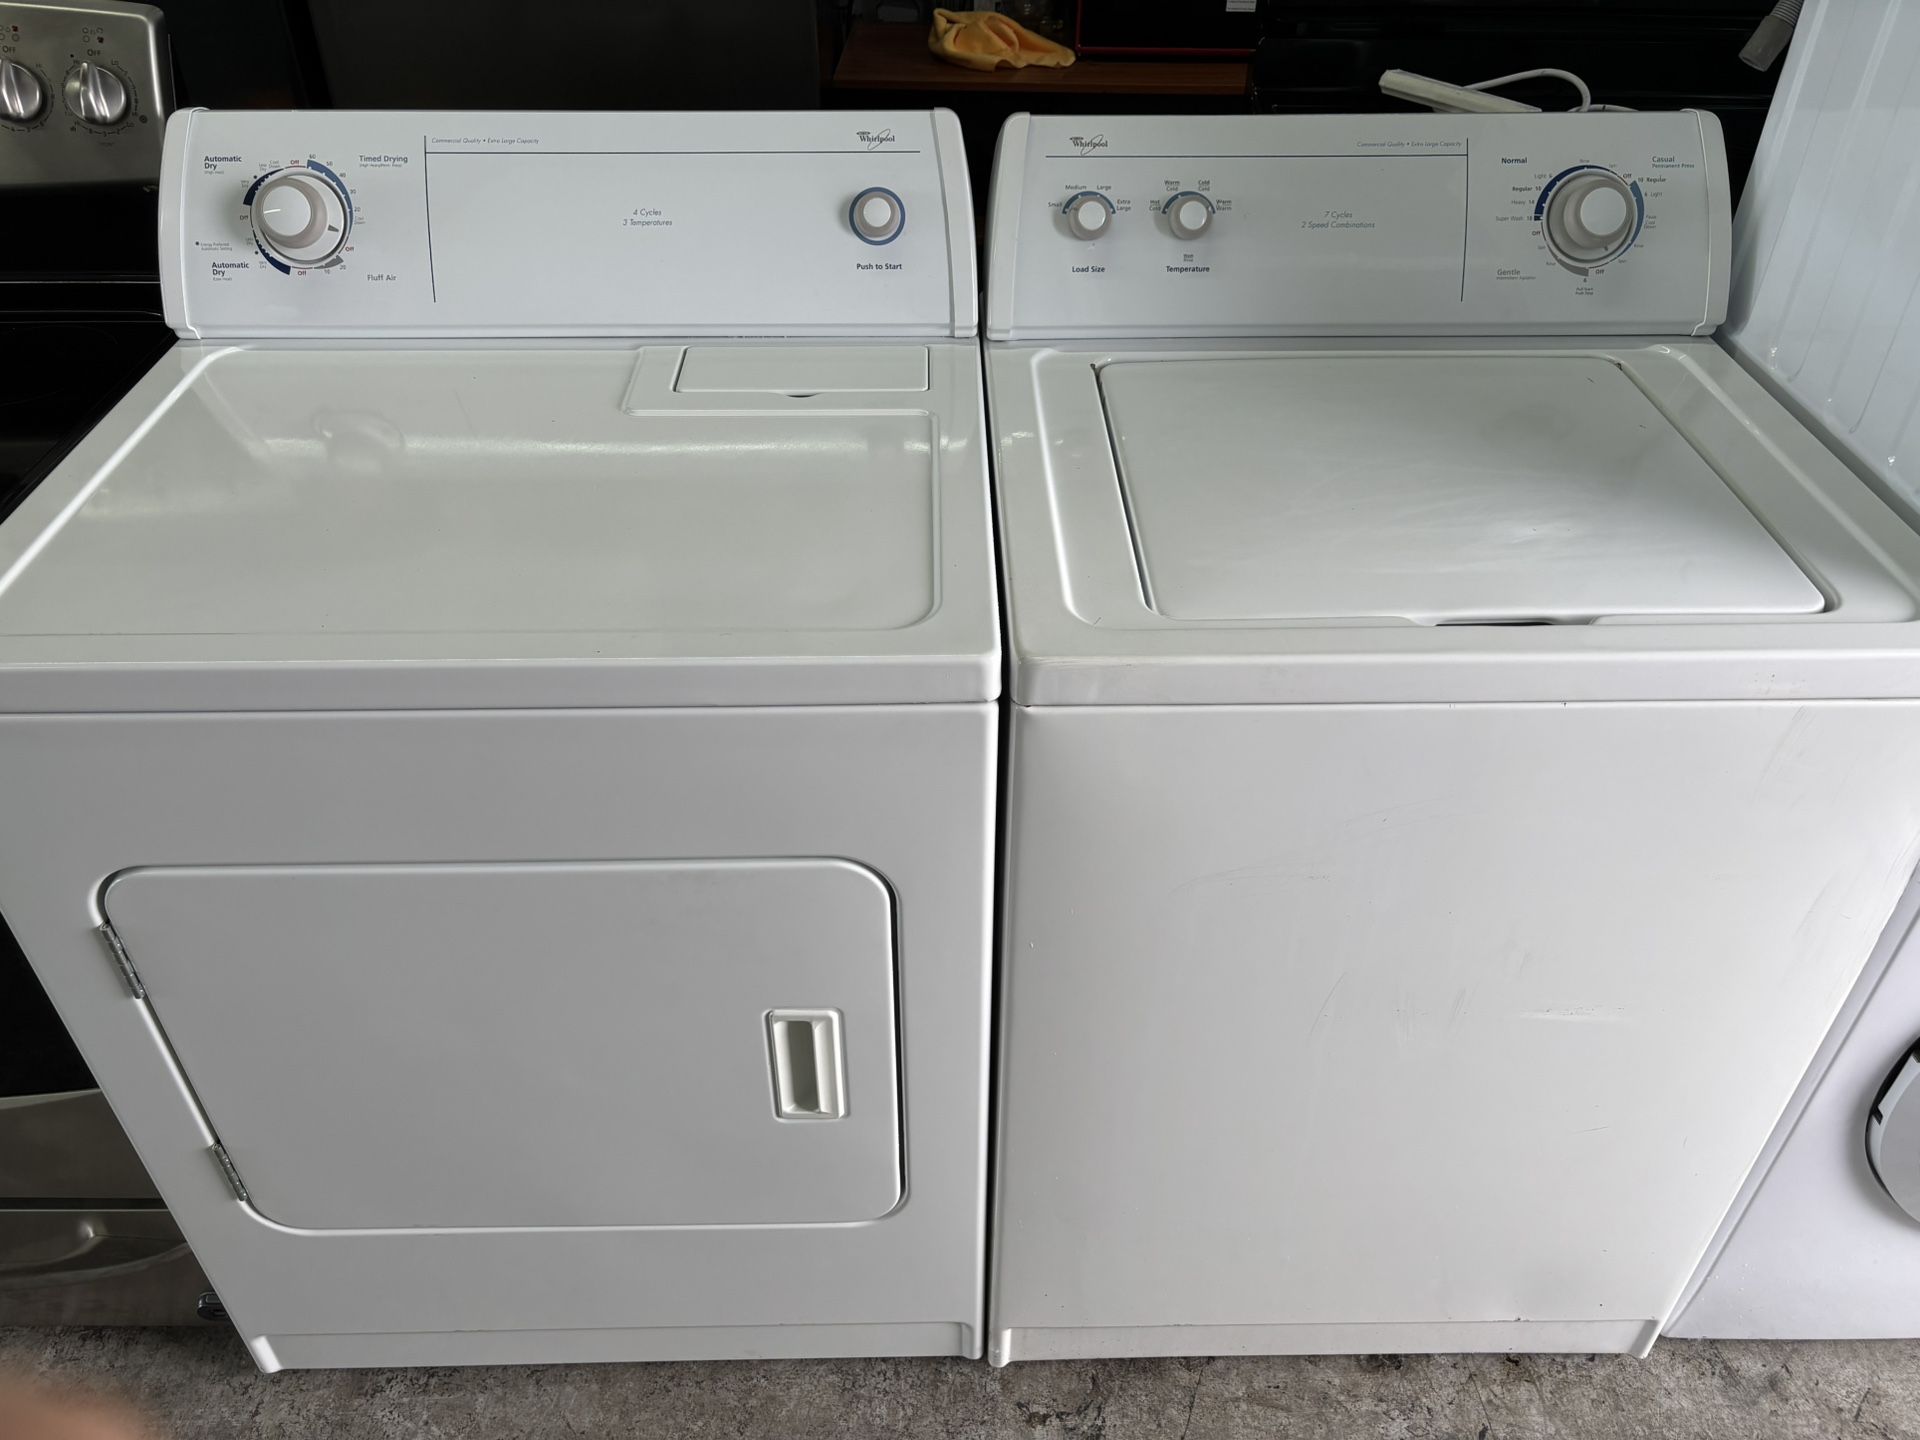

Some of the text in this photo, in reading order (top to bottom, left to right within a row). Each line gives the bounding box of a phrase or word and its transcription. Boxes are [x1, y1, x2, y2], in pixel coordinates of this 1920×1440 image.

[204, 155, 242, 163] Automatic
[359, 155, 408, 164] Timed Drying
[204, 163, 217, 171] Dry
[633, 208, 662, 217] 4 Cycles
[1331, 210, 1353, 219] Cycles
[630, 218, 673, 228] Temperatures
[1308, 221, 1329, 229] Speed
[1330, 221, 1376, 229] Combinations
[856, 262, 874, 270] Push
[884, 262, 903, 270] Start
[1166, 265, 1210, 274] Temperature
[212, 269, 226, 277] Dry
[1497, 268, 1521, 276] Gentle
